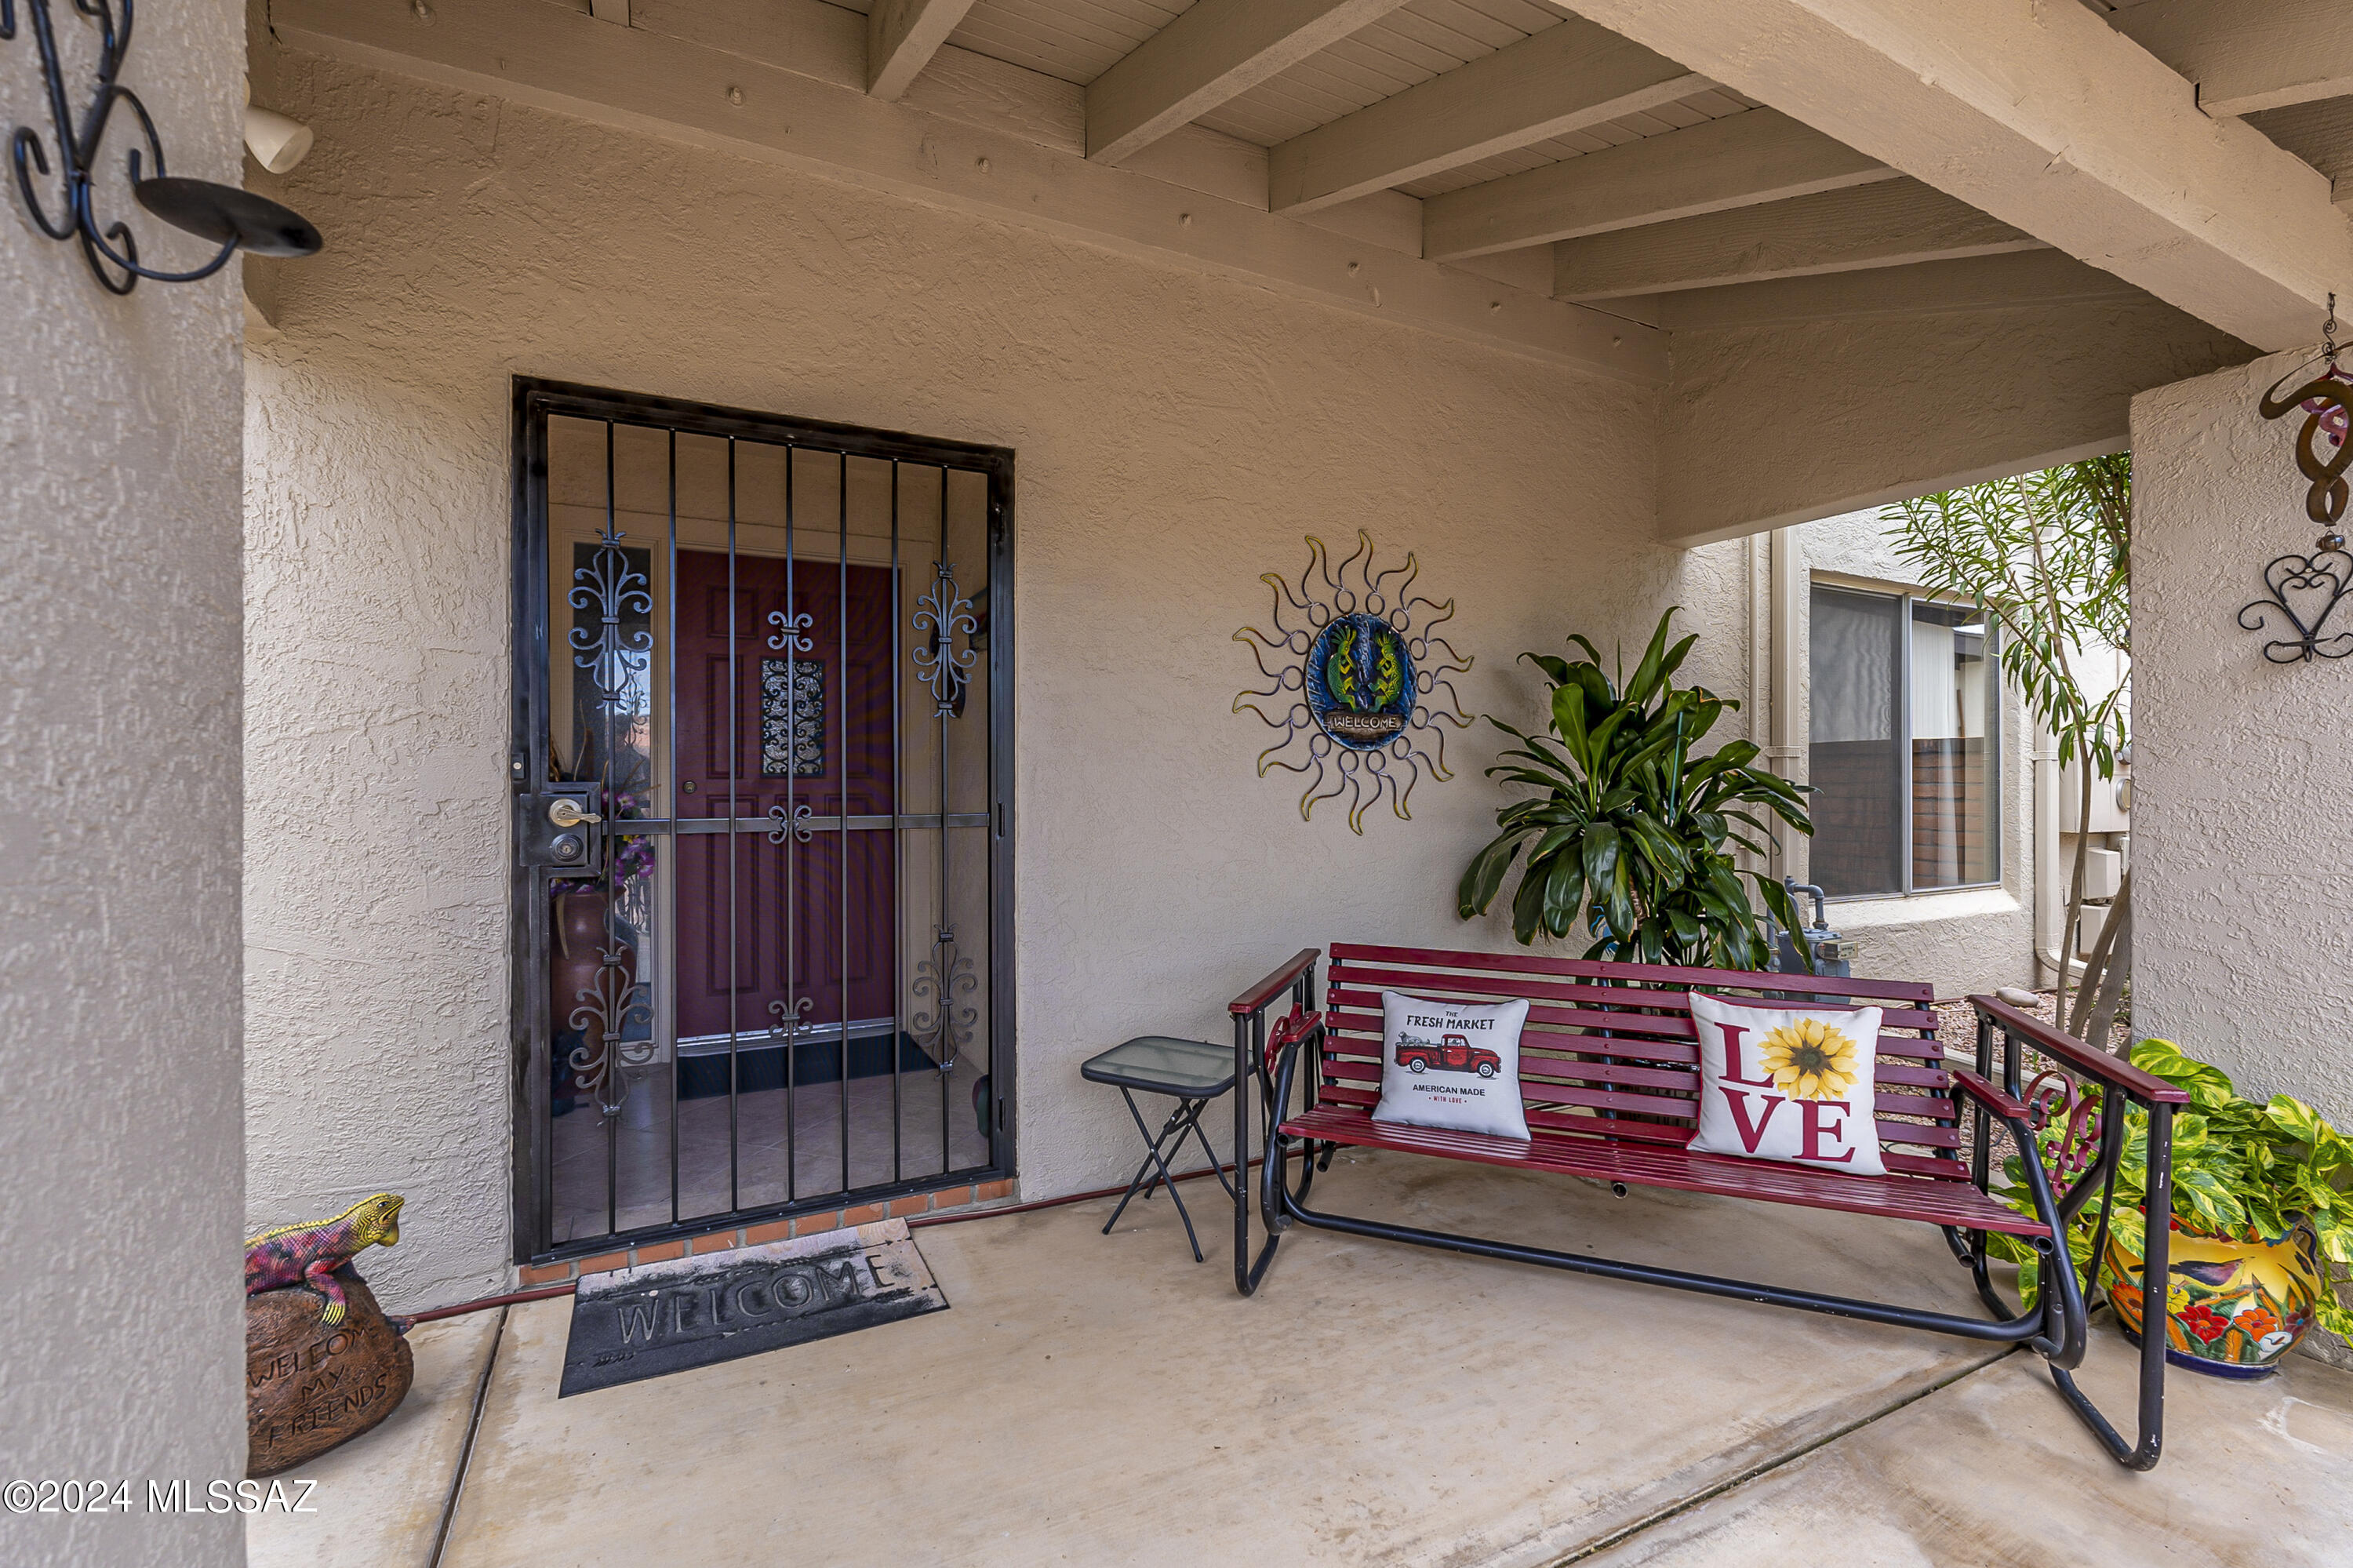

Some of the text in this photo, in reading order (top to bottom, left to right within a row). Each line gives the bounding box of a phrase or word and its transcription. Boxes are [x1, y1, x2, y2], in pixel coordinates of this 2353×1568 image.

[1333, 716, 1397, 729] WELCOME
[1407, 1016, 1495, 1030] FRESH MARKET
[1413, 1084, 1458, 1094] AMERICAN
[616, 1253, 896, 1344] WELCOME
[300, 1364, 345, 1403] MY
[267, 1373, 387, 1449] FRIENDS
